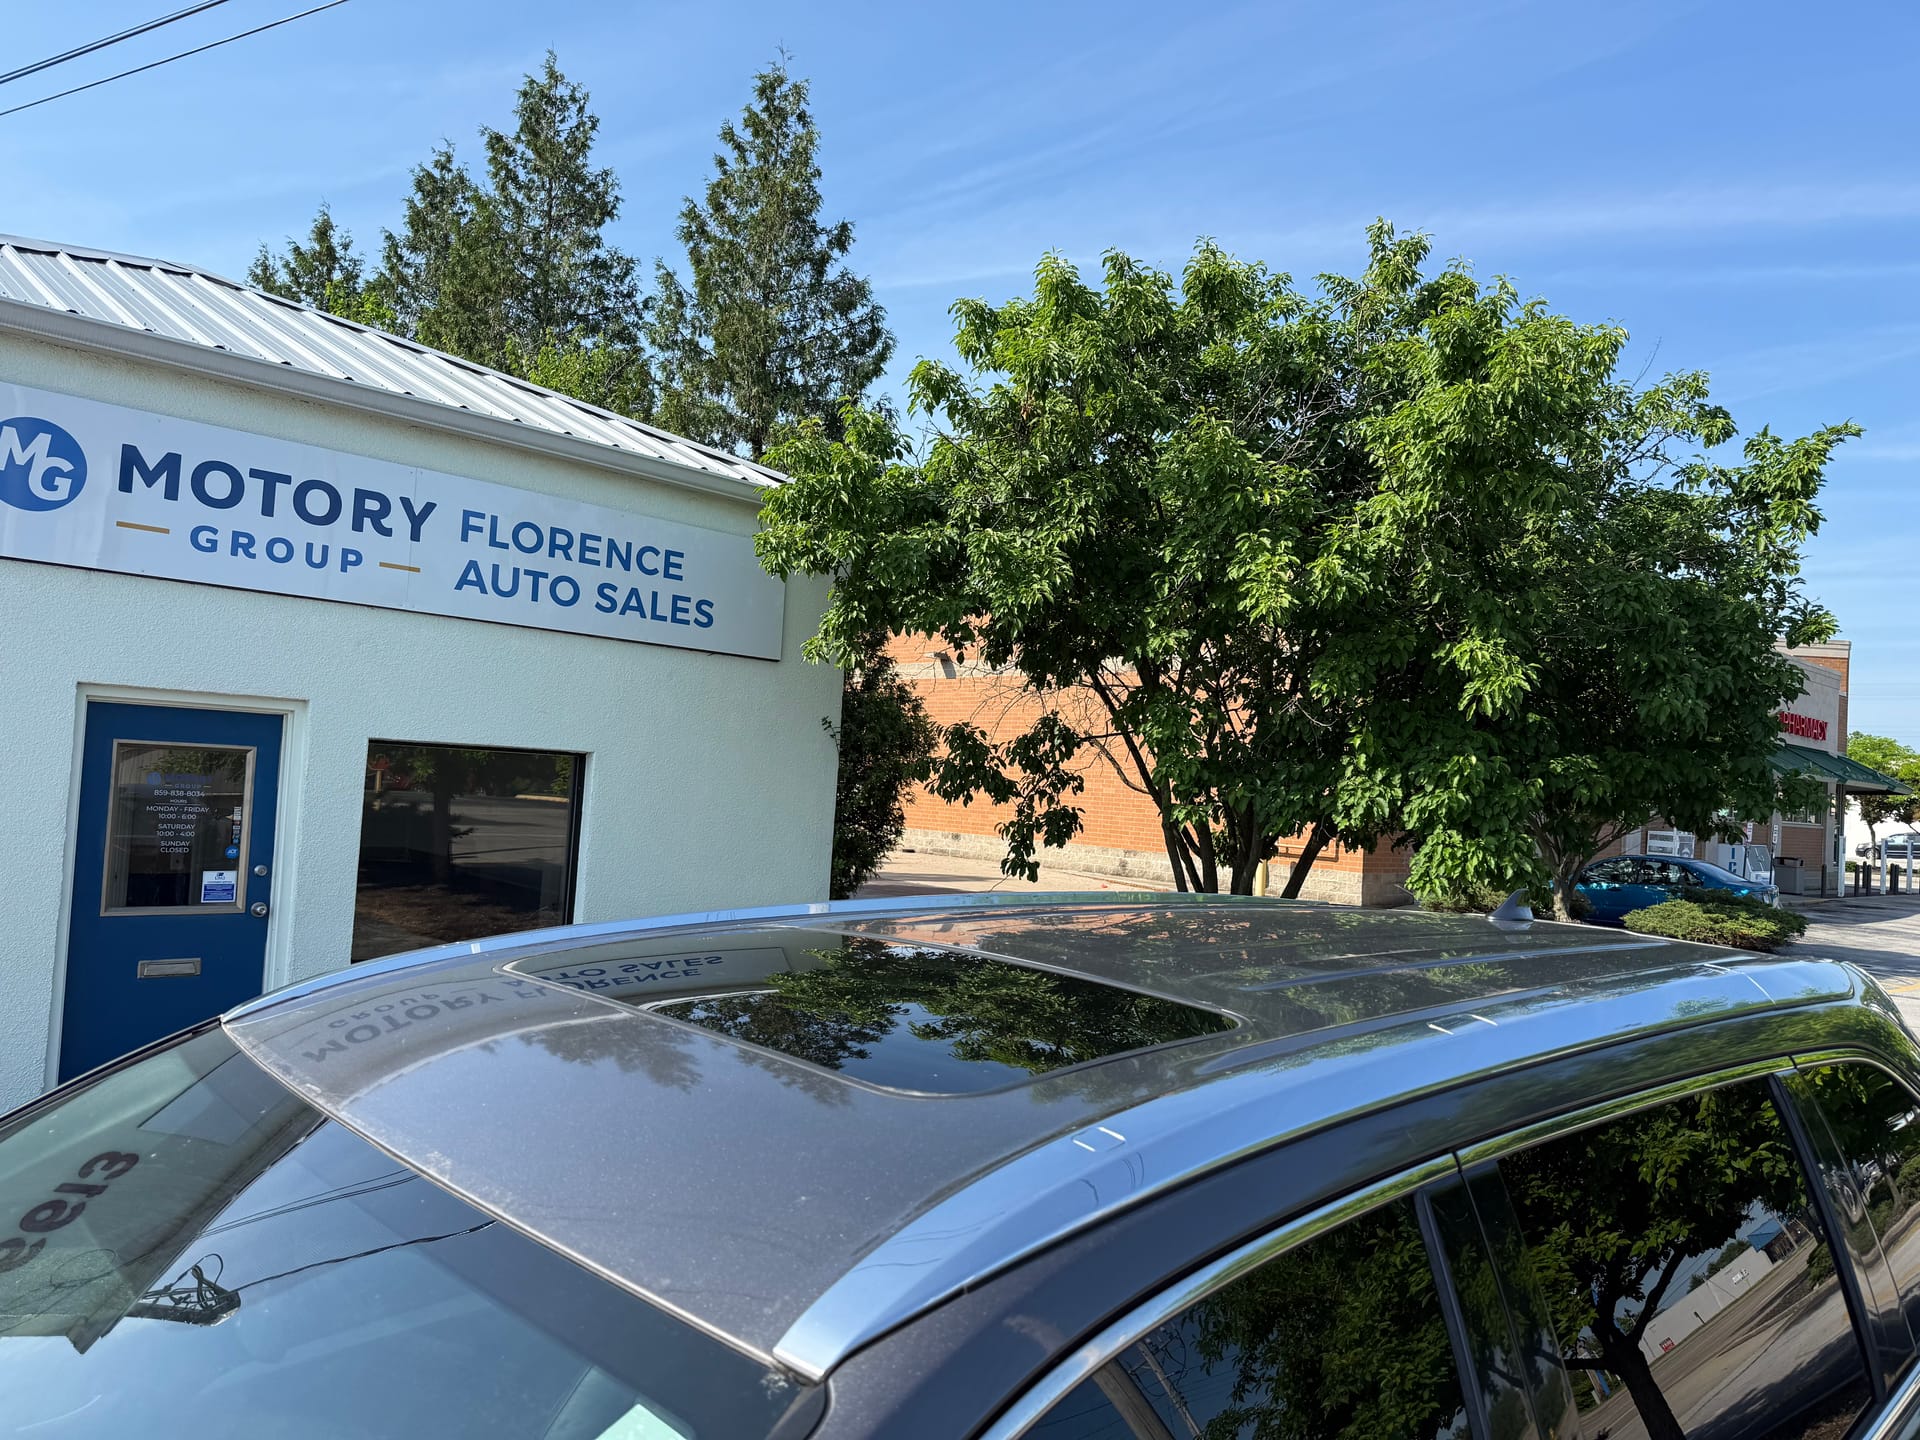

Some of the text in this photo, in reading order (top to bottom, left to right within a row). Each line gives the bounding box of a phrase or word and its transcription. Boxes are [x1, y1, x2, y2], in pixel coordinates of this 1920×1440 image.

[0, 425, 75, 501] MG
[118, 443, 437, 543] MOTORY
[190, 525, 363, 573] GROUP
[460, 509, 685, 581] FLORENCE
[454, 559, 714, 628] AUTO SALES
[1781, 711, 1829, 741] PHARMACY
